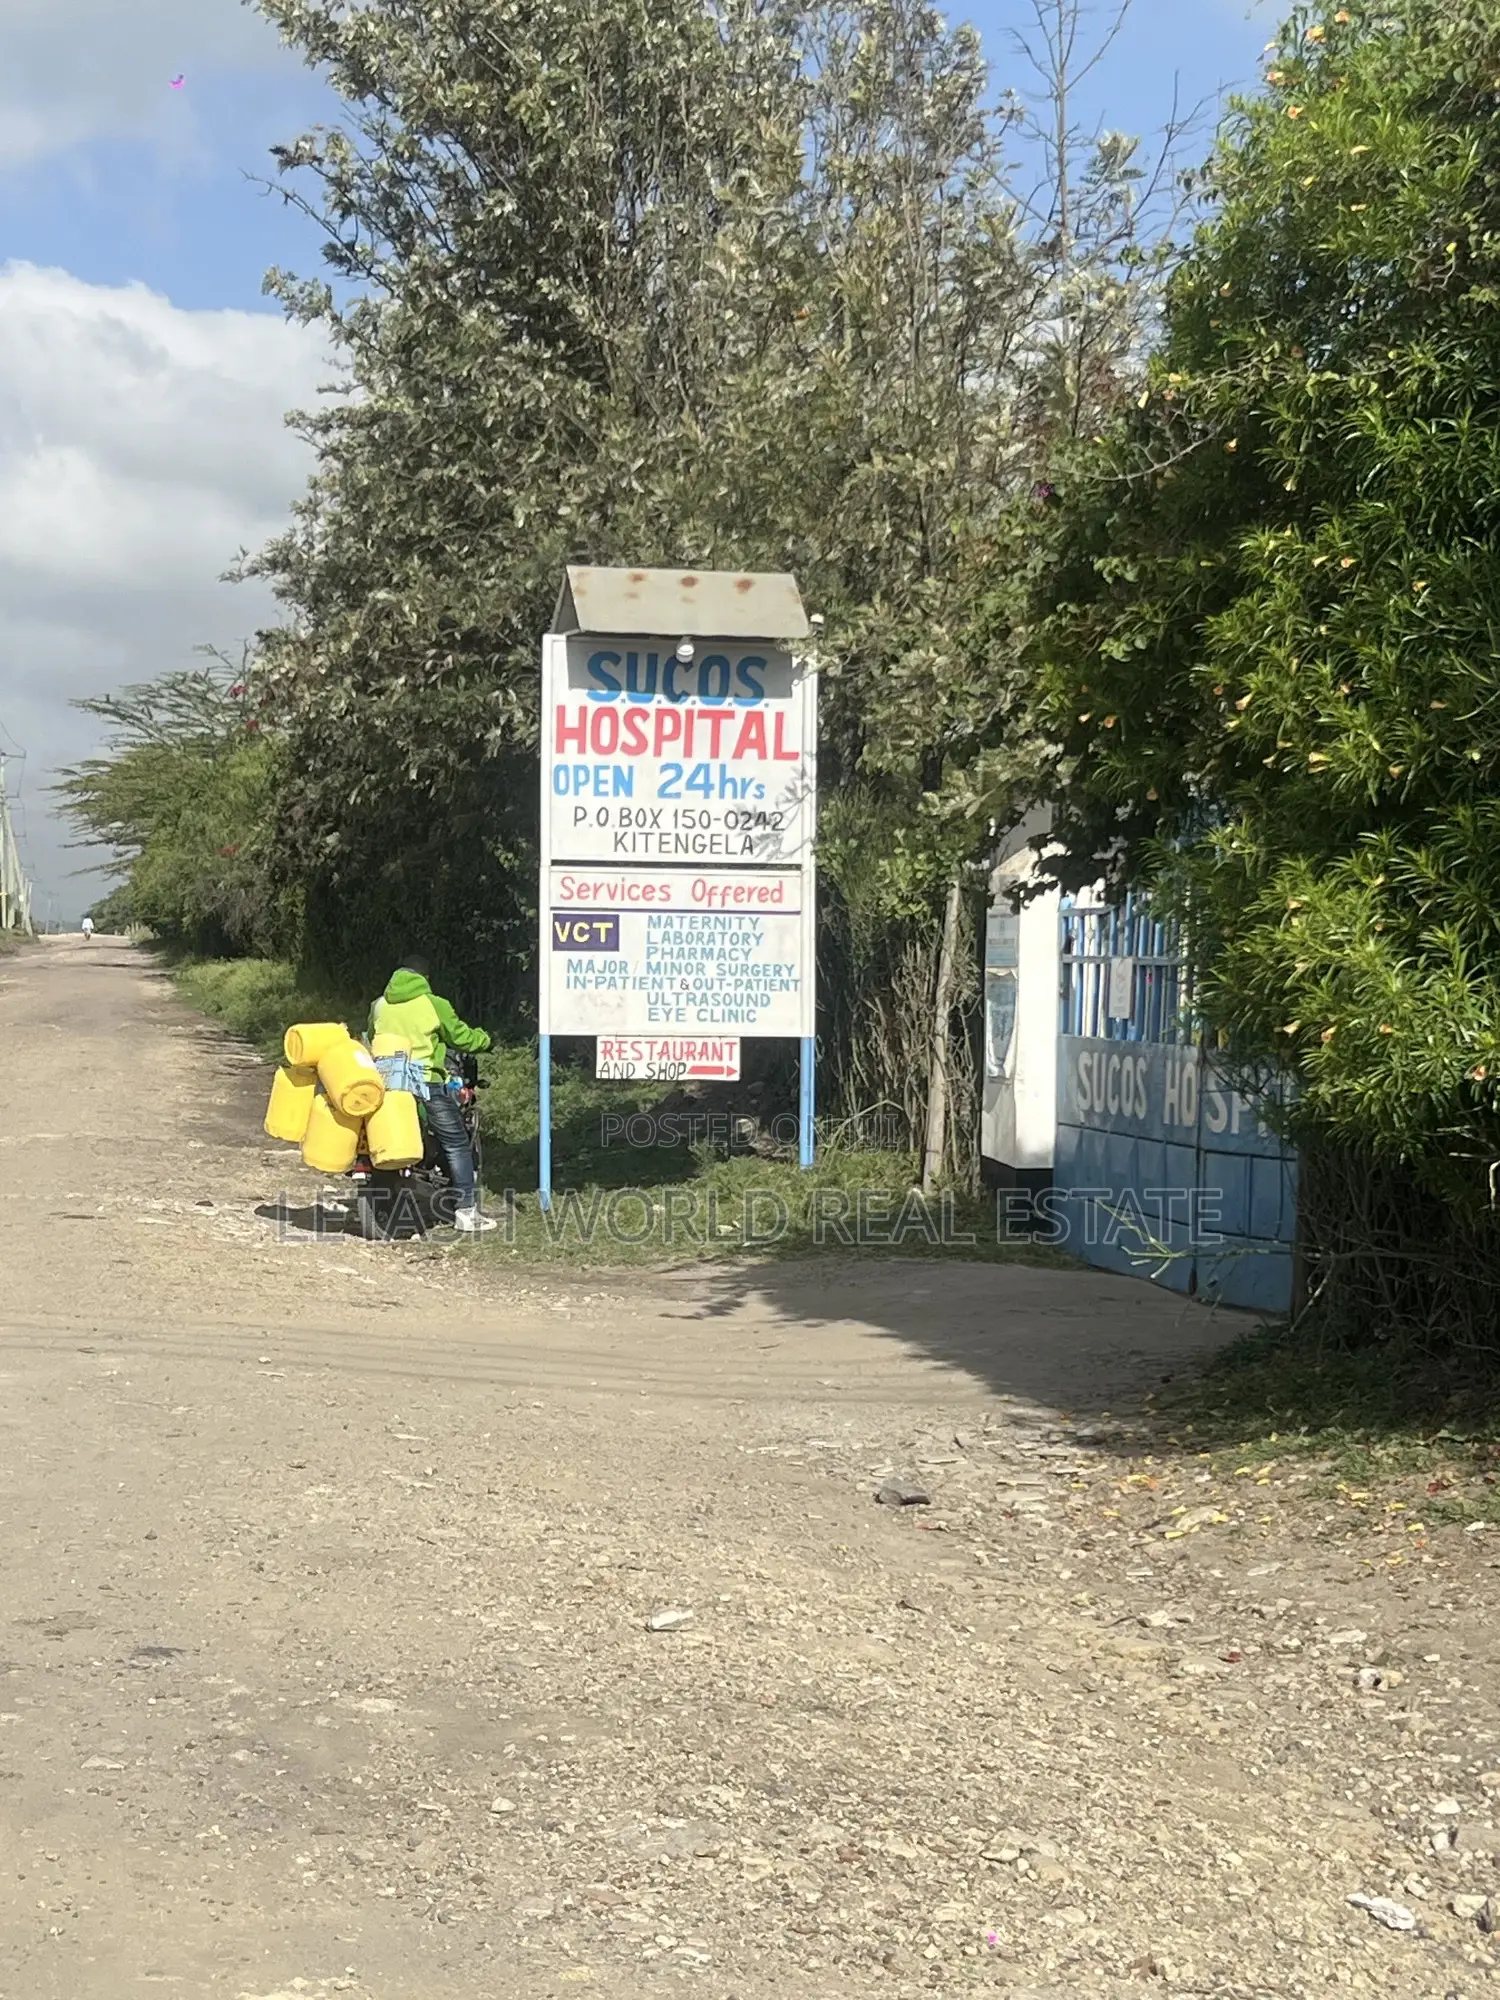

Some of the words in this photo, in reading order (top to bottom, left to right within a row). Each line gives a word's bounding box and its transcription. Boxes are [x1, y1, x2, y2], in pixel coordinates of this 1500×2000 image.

[555, 705, 800, 761] HOSPITAL
[553, 764, 634, 797] OPEN
[657, 762, 765, 800] 24hrs
[613, 831, 754, 856] KITENGELA
[560, 876, 671, 902] Services
[691, 879, 783, 907] Offered
[554, 921, 613, 943] VCT
[647, 915, 760, 930] MATERNITY
[646, 931, 764, 946] LABORATORY
[646, 947, 752, 962] PHARMACY
[567, 959, 628, 975] MAJOR
[646, 962, 706, 976] MINOR
[716, 963, 795, 977] SURGERY
[566, 976, 676, 991] IN-PATIENT
[680, 978, 690, 991] &
[693, 978, 800, 992] OUT-PATIENT
[646, 992, 771, 1008] ULTRASOUND
[648, 1007, 686, 1022] EYE
[696, 1008, 757, 1023] CLINIC
[600, 1040, 738, 1062] RESTAURANT
[598, 1061, 635, 1079] AND
[645, 1061, 687, 1080] SHOP
[1078, 1051, 1147, 1120] SUCOS
